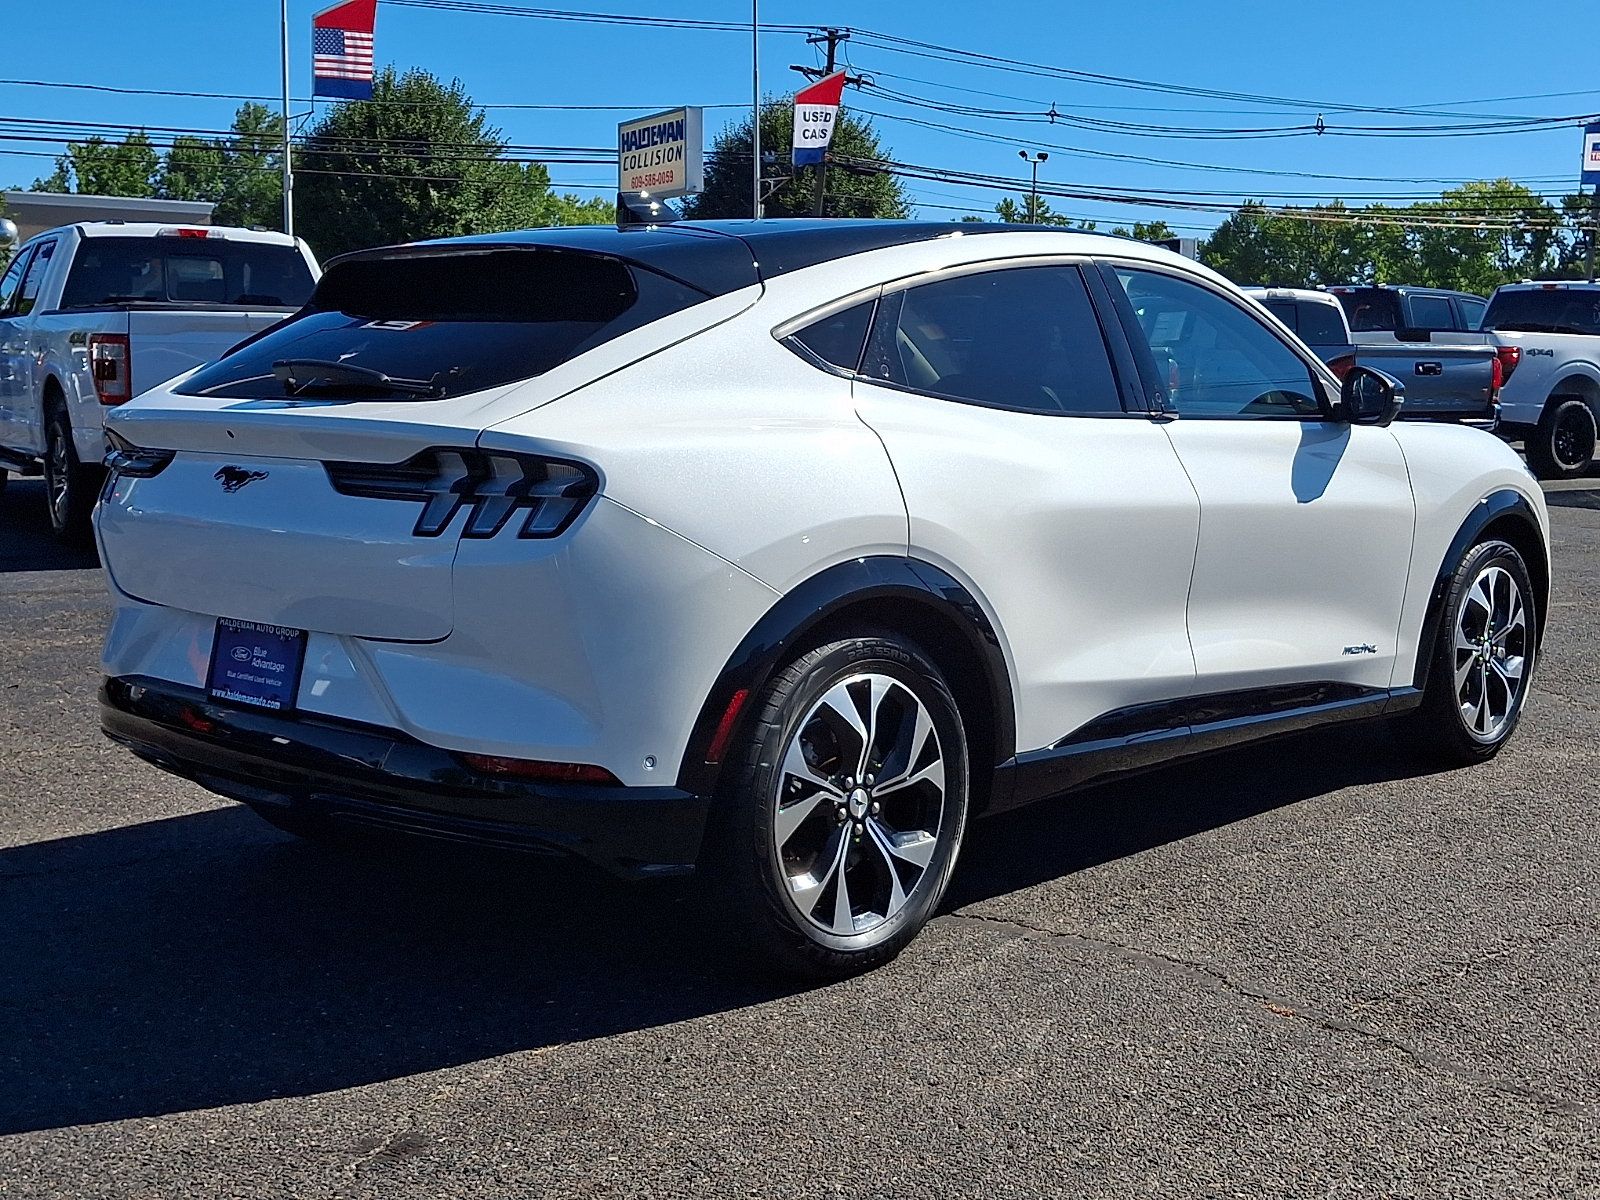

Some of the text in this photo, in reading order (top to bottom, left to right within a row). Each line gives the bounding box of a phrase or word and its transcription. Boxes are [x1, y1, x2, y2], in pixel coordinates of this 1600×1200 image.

[803, 111, 831, 122] USED
[621, 119, 684, 153] HALDEMAN
[802, 128, 828, 139] CAS
[623, 144, 683, 171] COLLISION
[631, 170, 674, 189] 609-586-0059
[220, 618, 300, 637] HALDEMAN AUTO GROUP
[253, 646, 267, 658] Blue
[251, 658, 285, 673] Advantage
